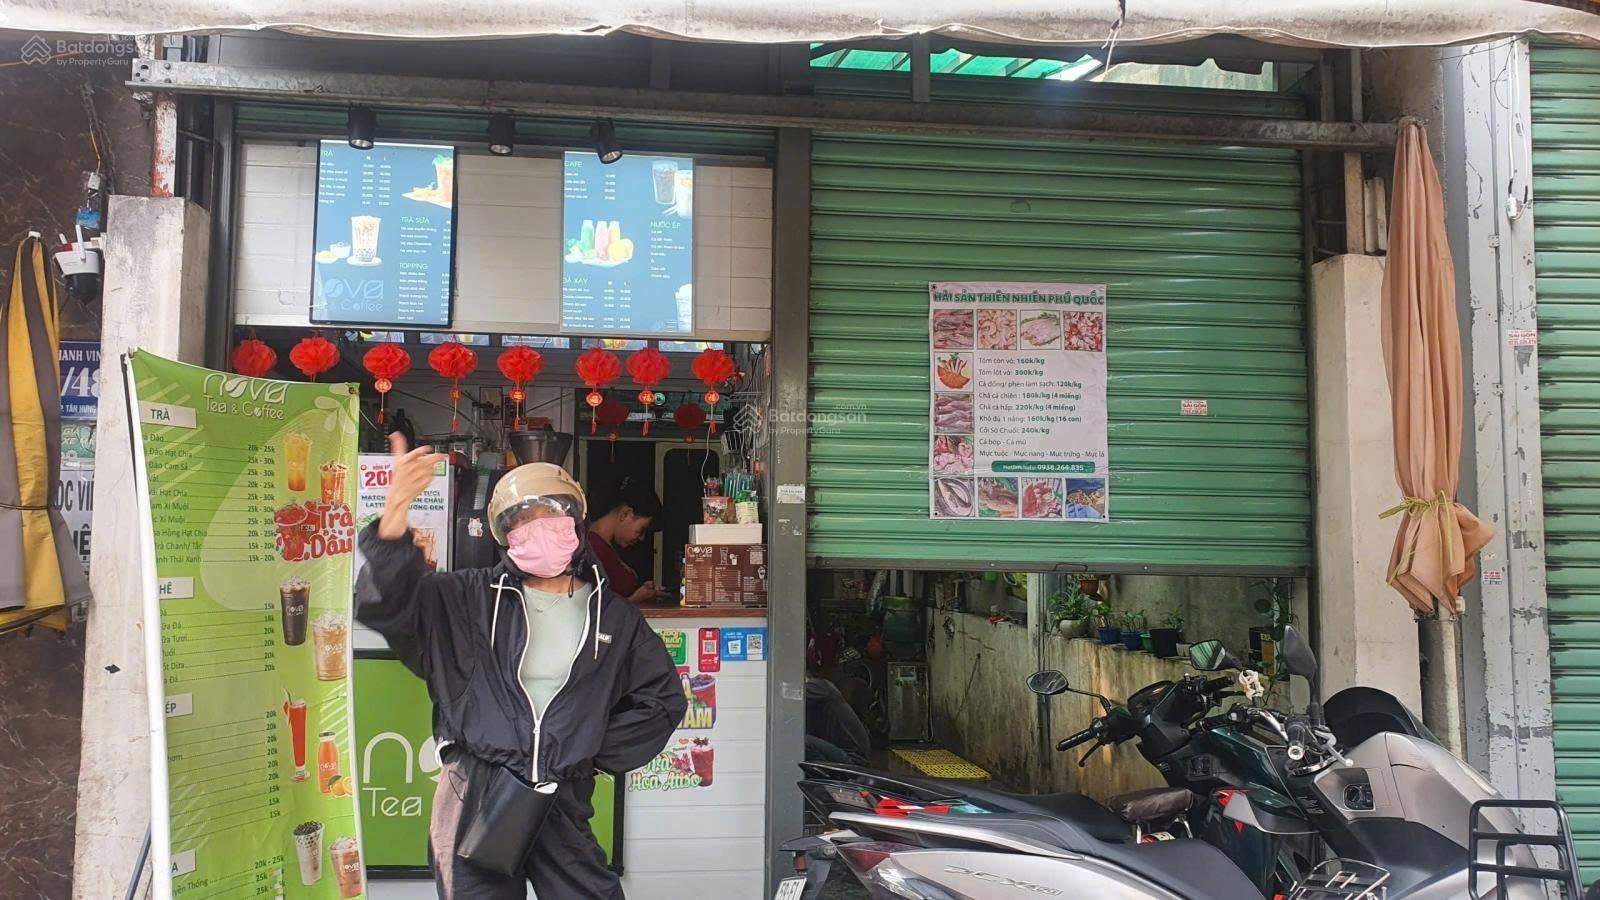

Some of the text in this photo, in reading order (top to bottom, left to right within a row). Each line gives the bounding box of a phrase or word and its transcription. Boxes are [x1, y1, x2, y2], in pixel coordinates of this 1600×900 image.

[399, 262, 428, 270] TOPPING
[933, 289, 1105, 306] HẢI SẢN THIÊN NHIÊN PHÚ QUỐC
[86, 350, 101, 362] VIN
[1016, 358, 1045, 366] 160k/kg
[1015, 369, 1044, 377] 300k/kg
[203, 372, 289, 405] nova
[1056, 381, 1082, 389] 120k/kg
[1022, 392, 1051, 400] 180k/kg
[203, 394, 287, 421] Tea & Coffee
[1015, 404, 1044, 412] 220k/kg
[1053, 403, 1076, 412] miếng)
[150, 408, 171, 421] TRÀ
[1027, 415, 1055, 424] 160k/kg
[1021, 427, 1050, 435] 240k/kg
[1036, 464, 1084, 472] 0938.264.835
[316, 502, 354, 530] Trà
[160, 581, 172, 594] HÊ
[264, 602, 275, 610] 15k
[165, 700, 177, 714] ÉP
[266, 710, 277, 719] 20k
[266, 722, 277, 731] 20k
[267, 735, 277, 743] 20k
[267, 747, 278, 756] 20k
[267, 760, 279, 768] 20k
[268, 772, 280, 781] 20k
[269, 785, 280, 793] 15k
[269, 797, 280, 806] 15k
[362, 787, 422, 817] Tea
[270, 809, 281, 819] 15k
[255, 860, 267, 869] 20k
[272, 855, 284, 865] 25k
[256, 872, 268, 882] 25k
[256, 885, 269, 895] 25k
